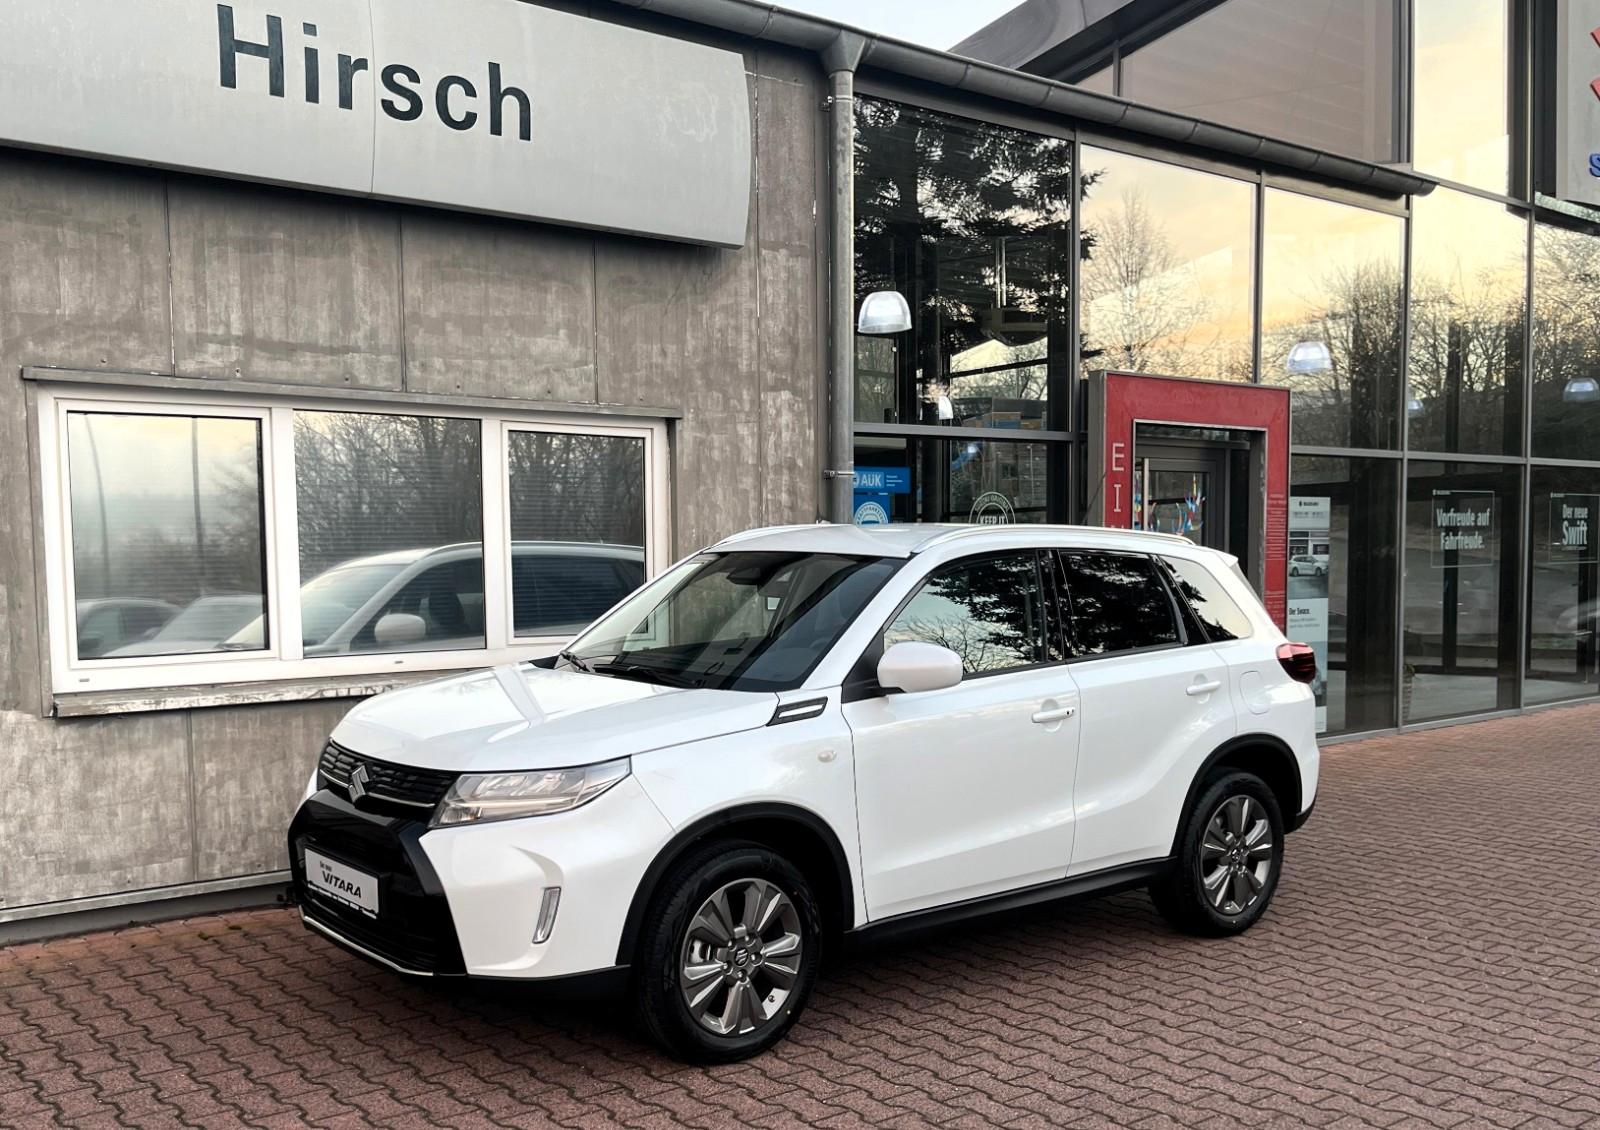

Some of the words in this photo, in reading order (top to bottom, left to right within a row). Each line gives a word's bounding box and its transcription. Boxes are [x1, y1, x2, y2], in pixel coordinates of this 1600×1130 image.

[217, 3, 531, 141] Hirsch
[1436, 507, 1475, 527] Vorfreude
[1477, 507, 1490, 526] auf
[1562, 520, 1587, 545] Swift
[322, 870, 362, 898] VITARA
